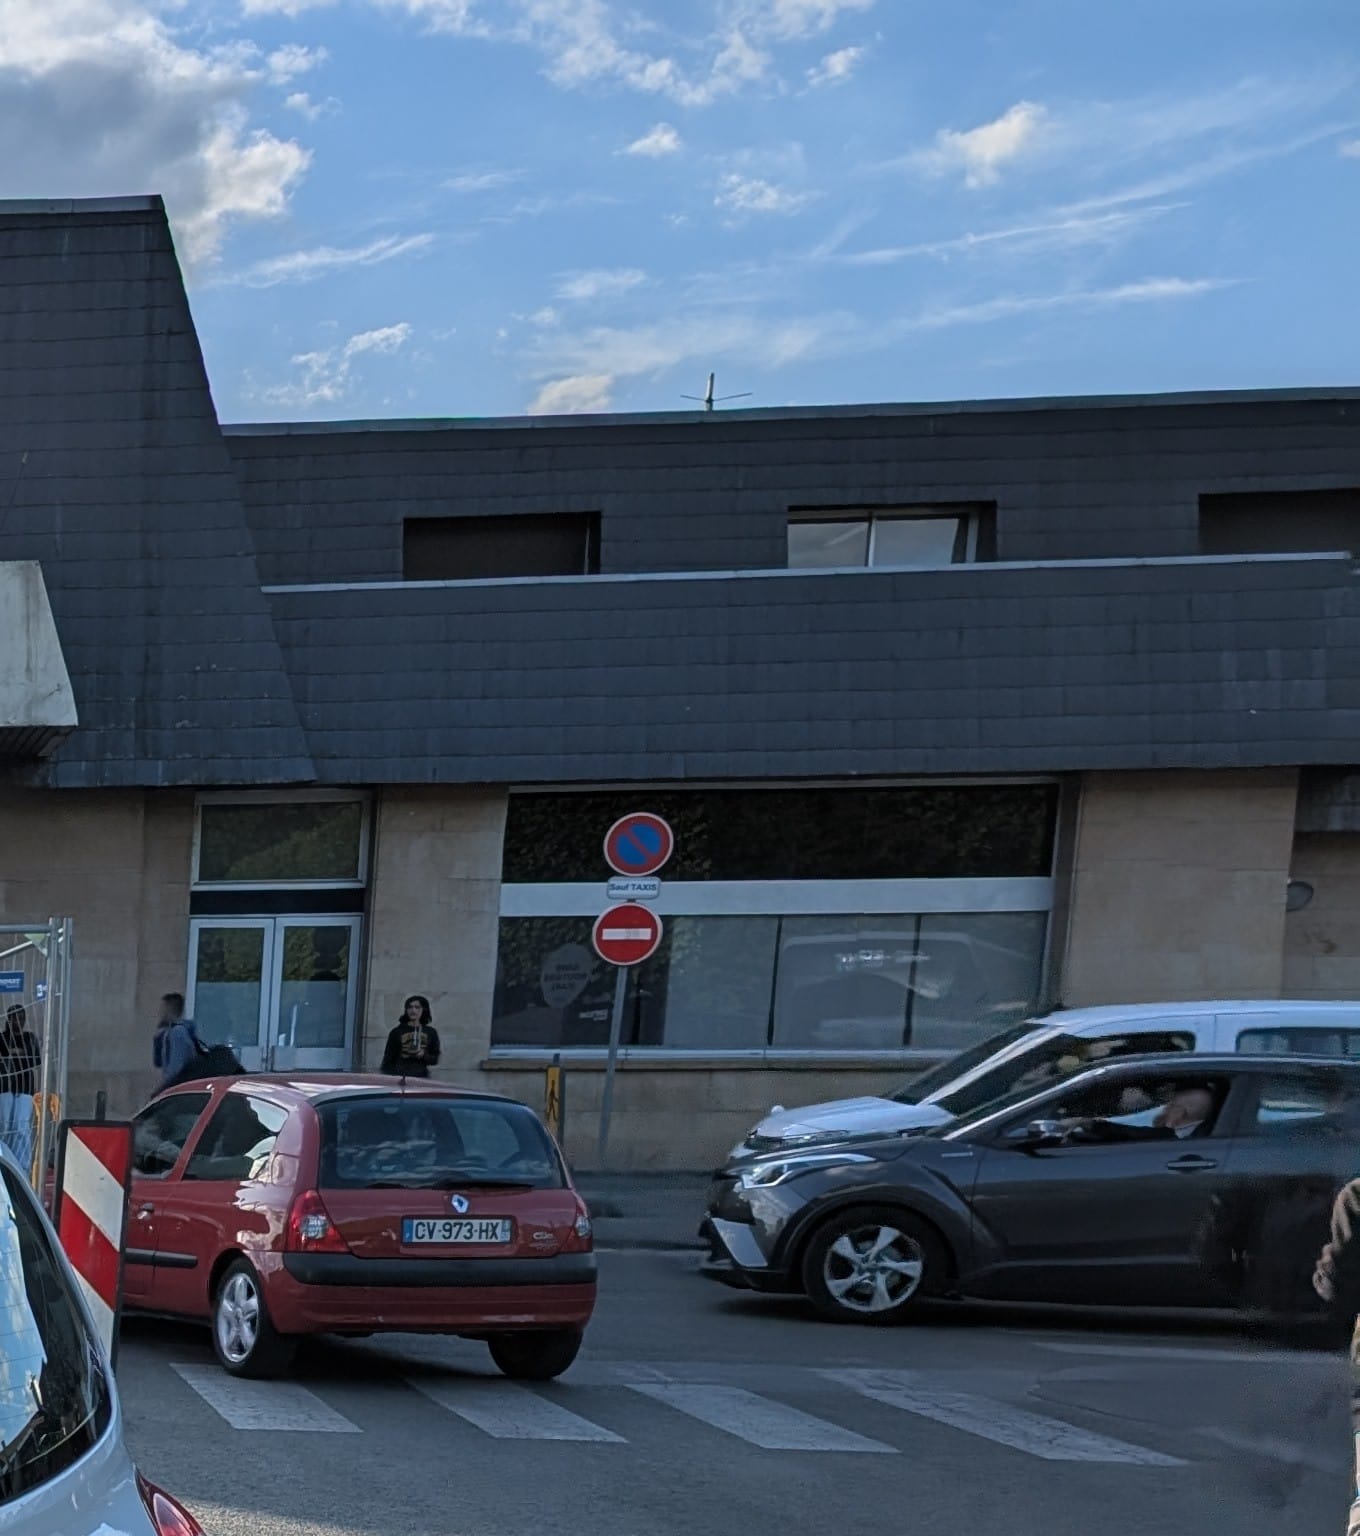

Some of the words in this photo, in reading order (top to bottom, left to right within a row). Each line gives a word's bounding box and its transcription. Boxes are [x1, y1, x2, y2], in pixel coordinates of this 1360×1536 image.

[609, 883, 630, 892] Sauf
[631, 883, 657, 892] TAXIS
[414, 1221, 499, 1241] CV-973-HX
